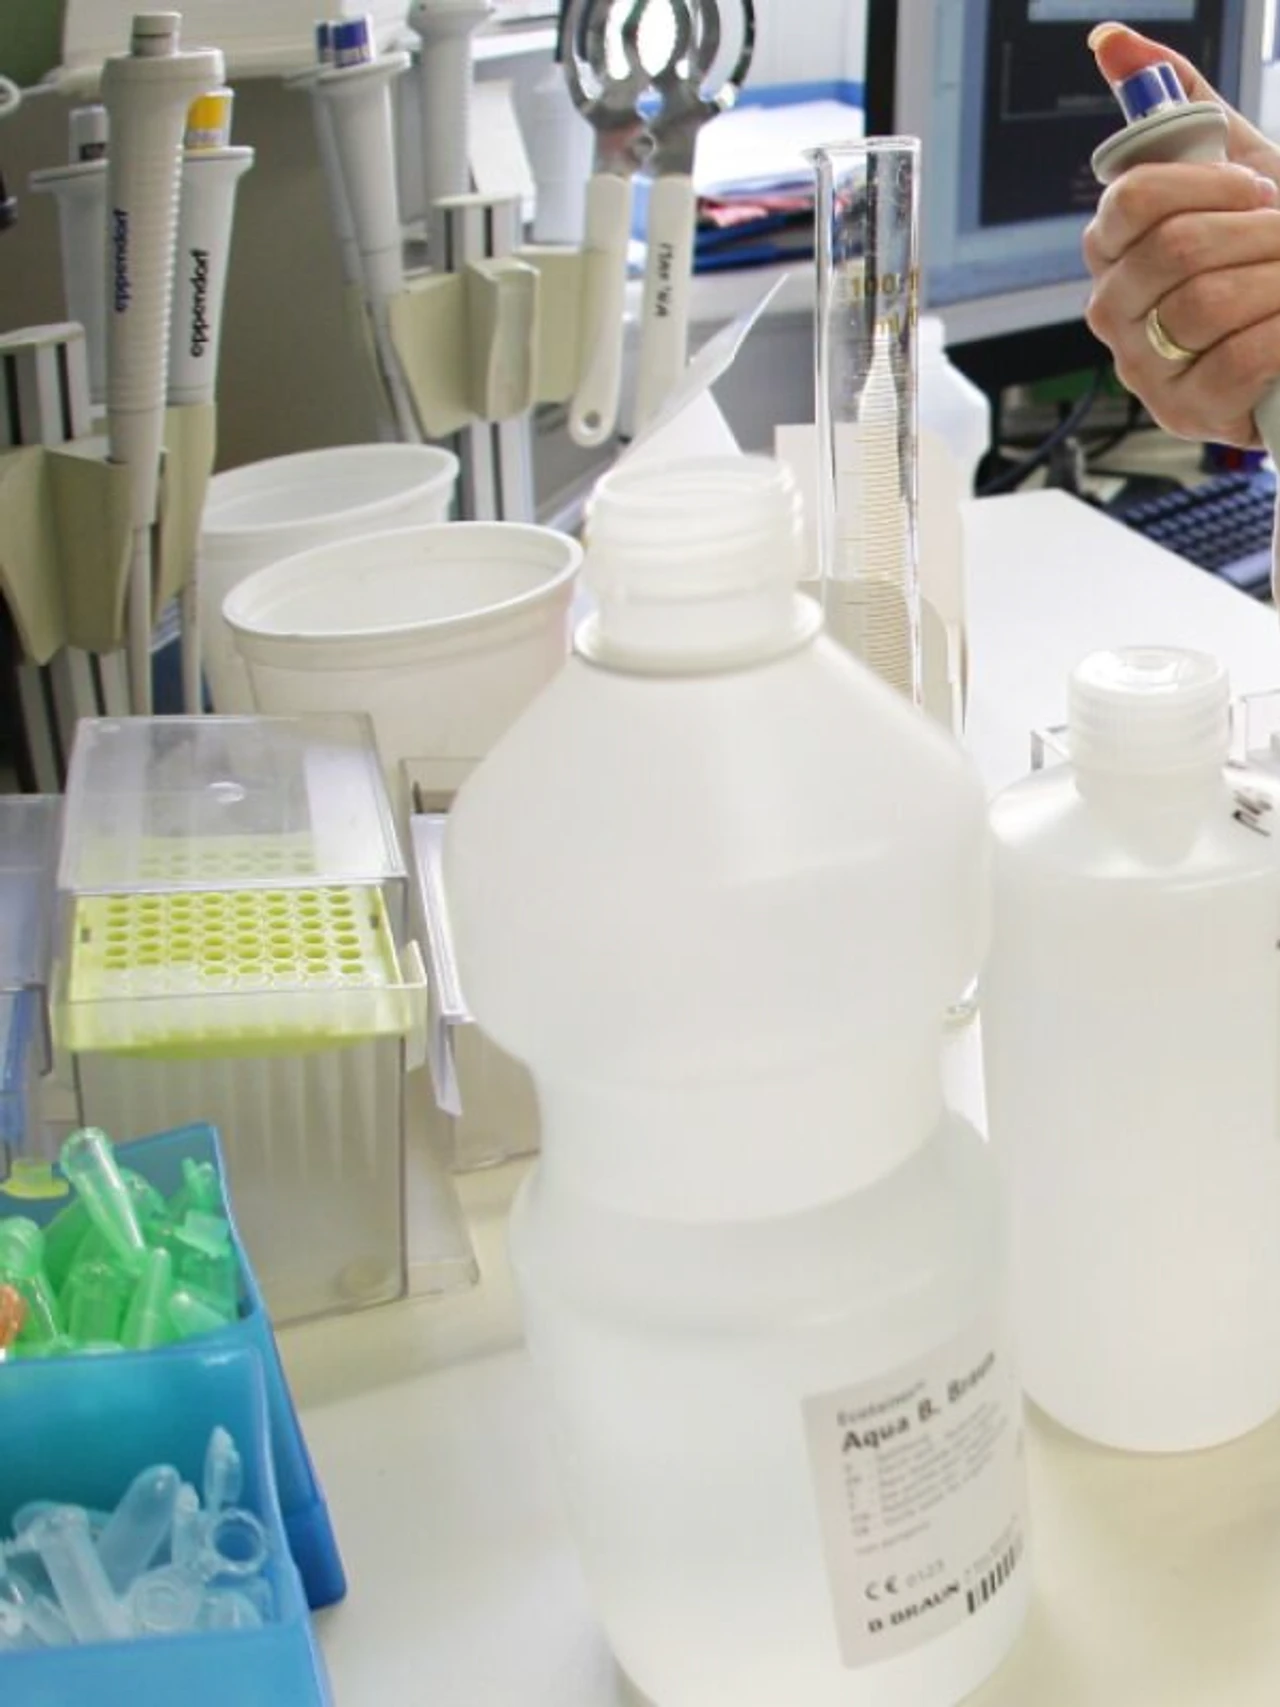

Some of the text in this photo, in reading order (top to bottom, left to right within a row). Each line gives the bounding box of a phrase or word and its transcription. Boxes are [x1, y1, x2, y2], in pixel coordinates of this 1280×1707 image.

[113, 208, 131, 313] eppendorf
[190, 249, 210, 358] eppendorf
[842, 1416, 911, 1453] Aqua
[917, 1398, 941, 1423] B.
[890, 1579, 961, 1626] BRAUN
